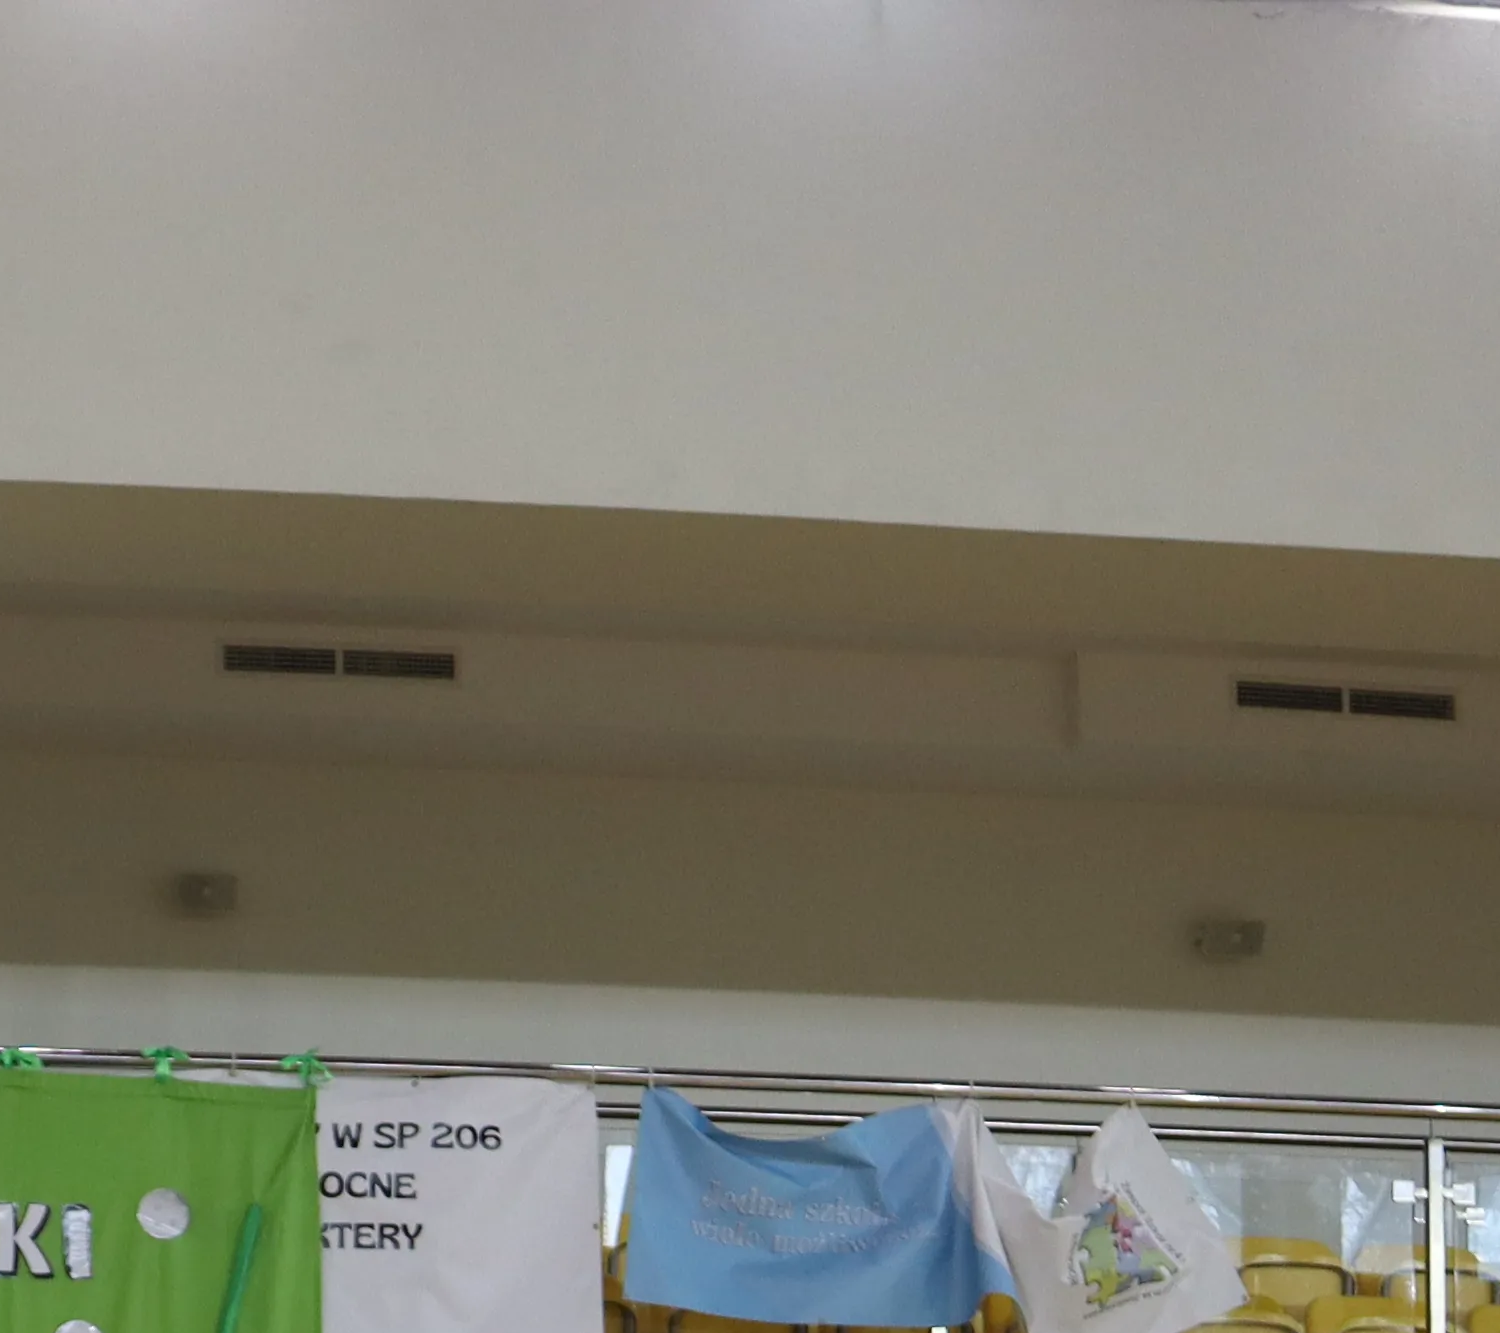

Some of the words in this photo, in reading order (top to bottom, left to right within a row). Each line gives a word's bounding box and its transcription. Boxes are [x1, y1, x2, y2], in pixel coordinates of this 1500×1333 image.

[332, 1122, 363, 1149] W
[373, 1121, 420, 1149] SP
[430, 1121, 503, 1151] 206
[318, 1170, 418, 1200] OCNE
